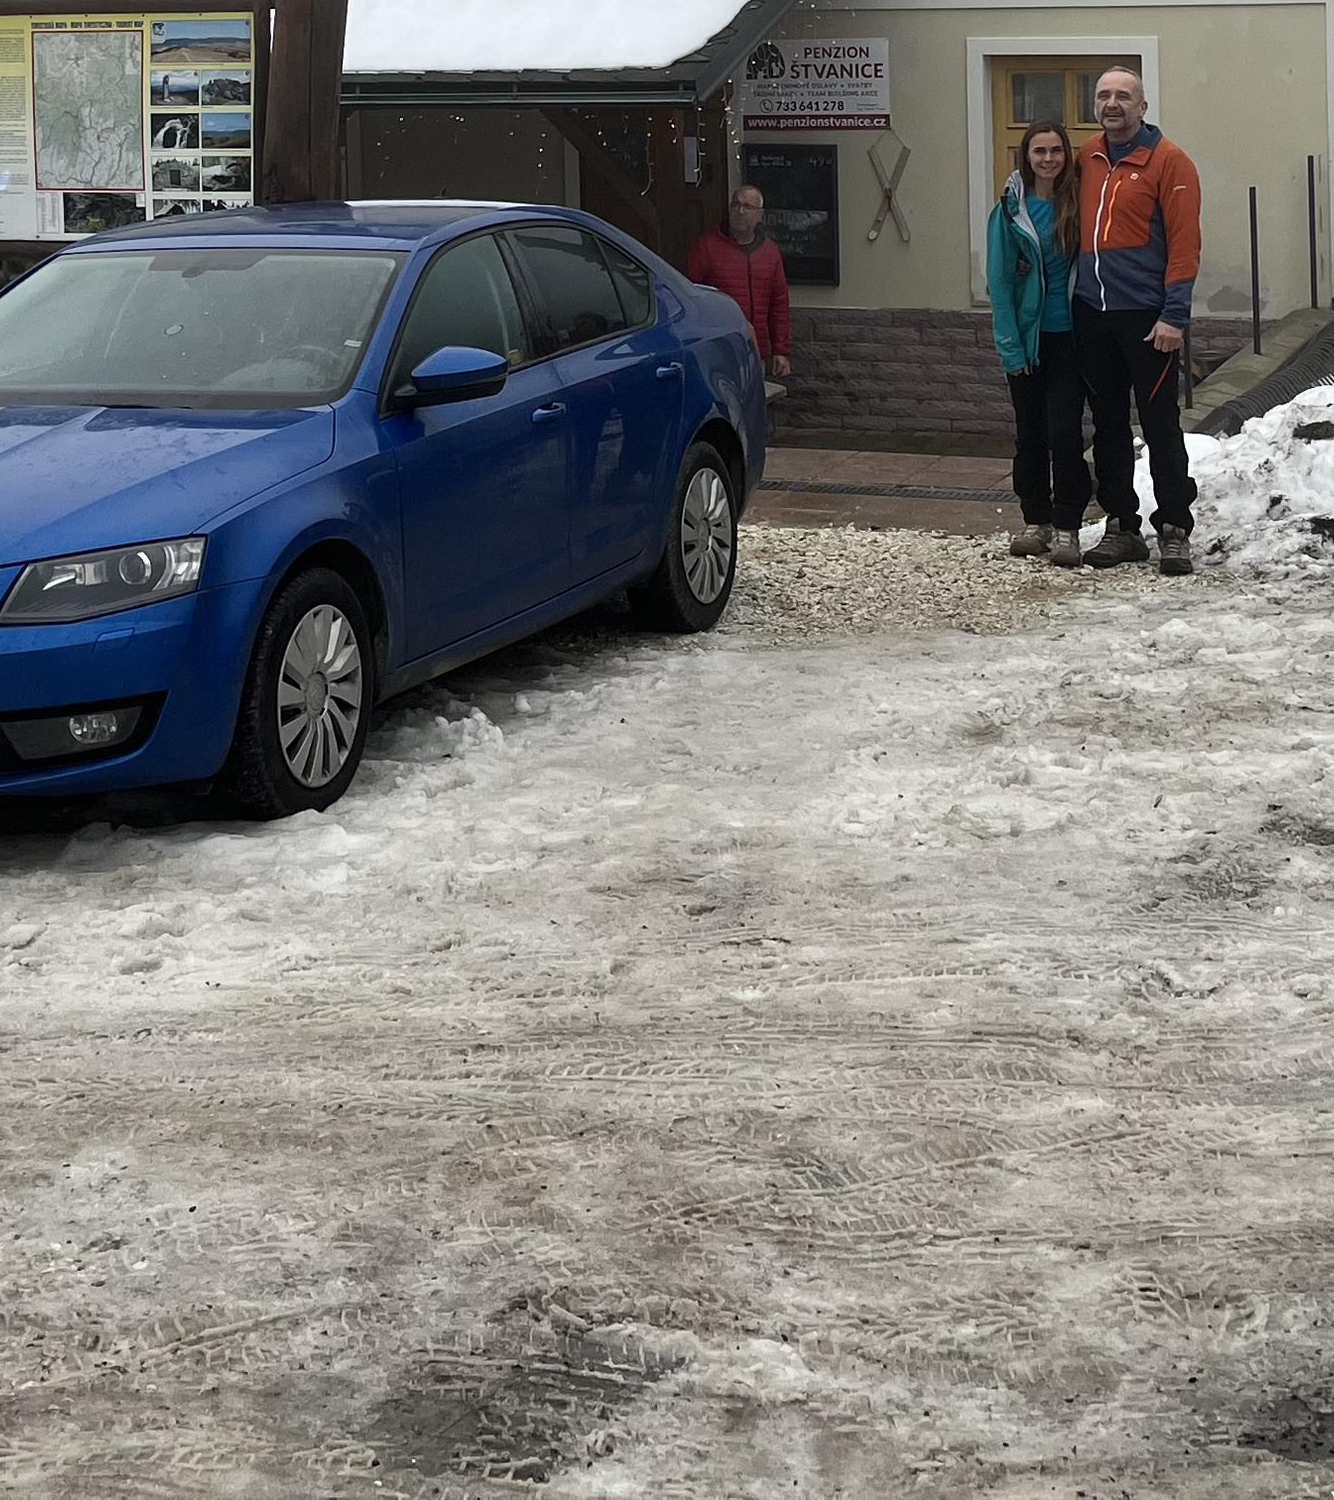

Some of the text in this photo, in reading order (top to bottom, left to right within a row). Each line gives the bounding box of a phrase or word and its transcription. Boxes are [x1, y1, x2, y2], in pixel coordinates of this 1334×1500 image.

[804, 46, 869, 59] PENZION
[790, 60, 884, 79] ŠTVANICE
[748, 116, 886, 128] www.penzionstvanice.cz
